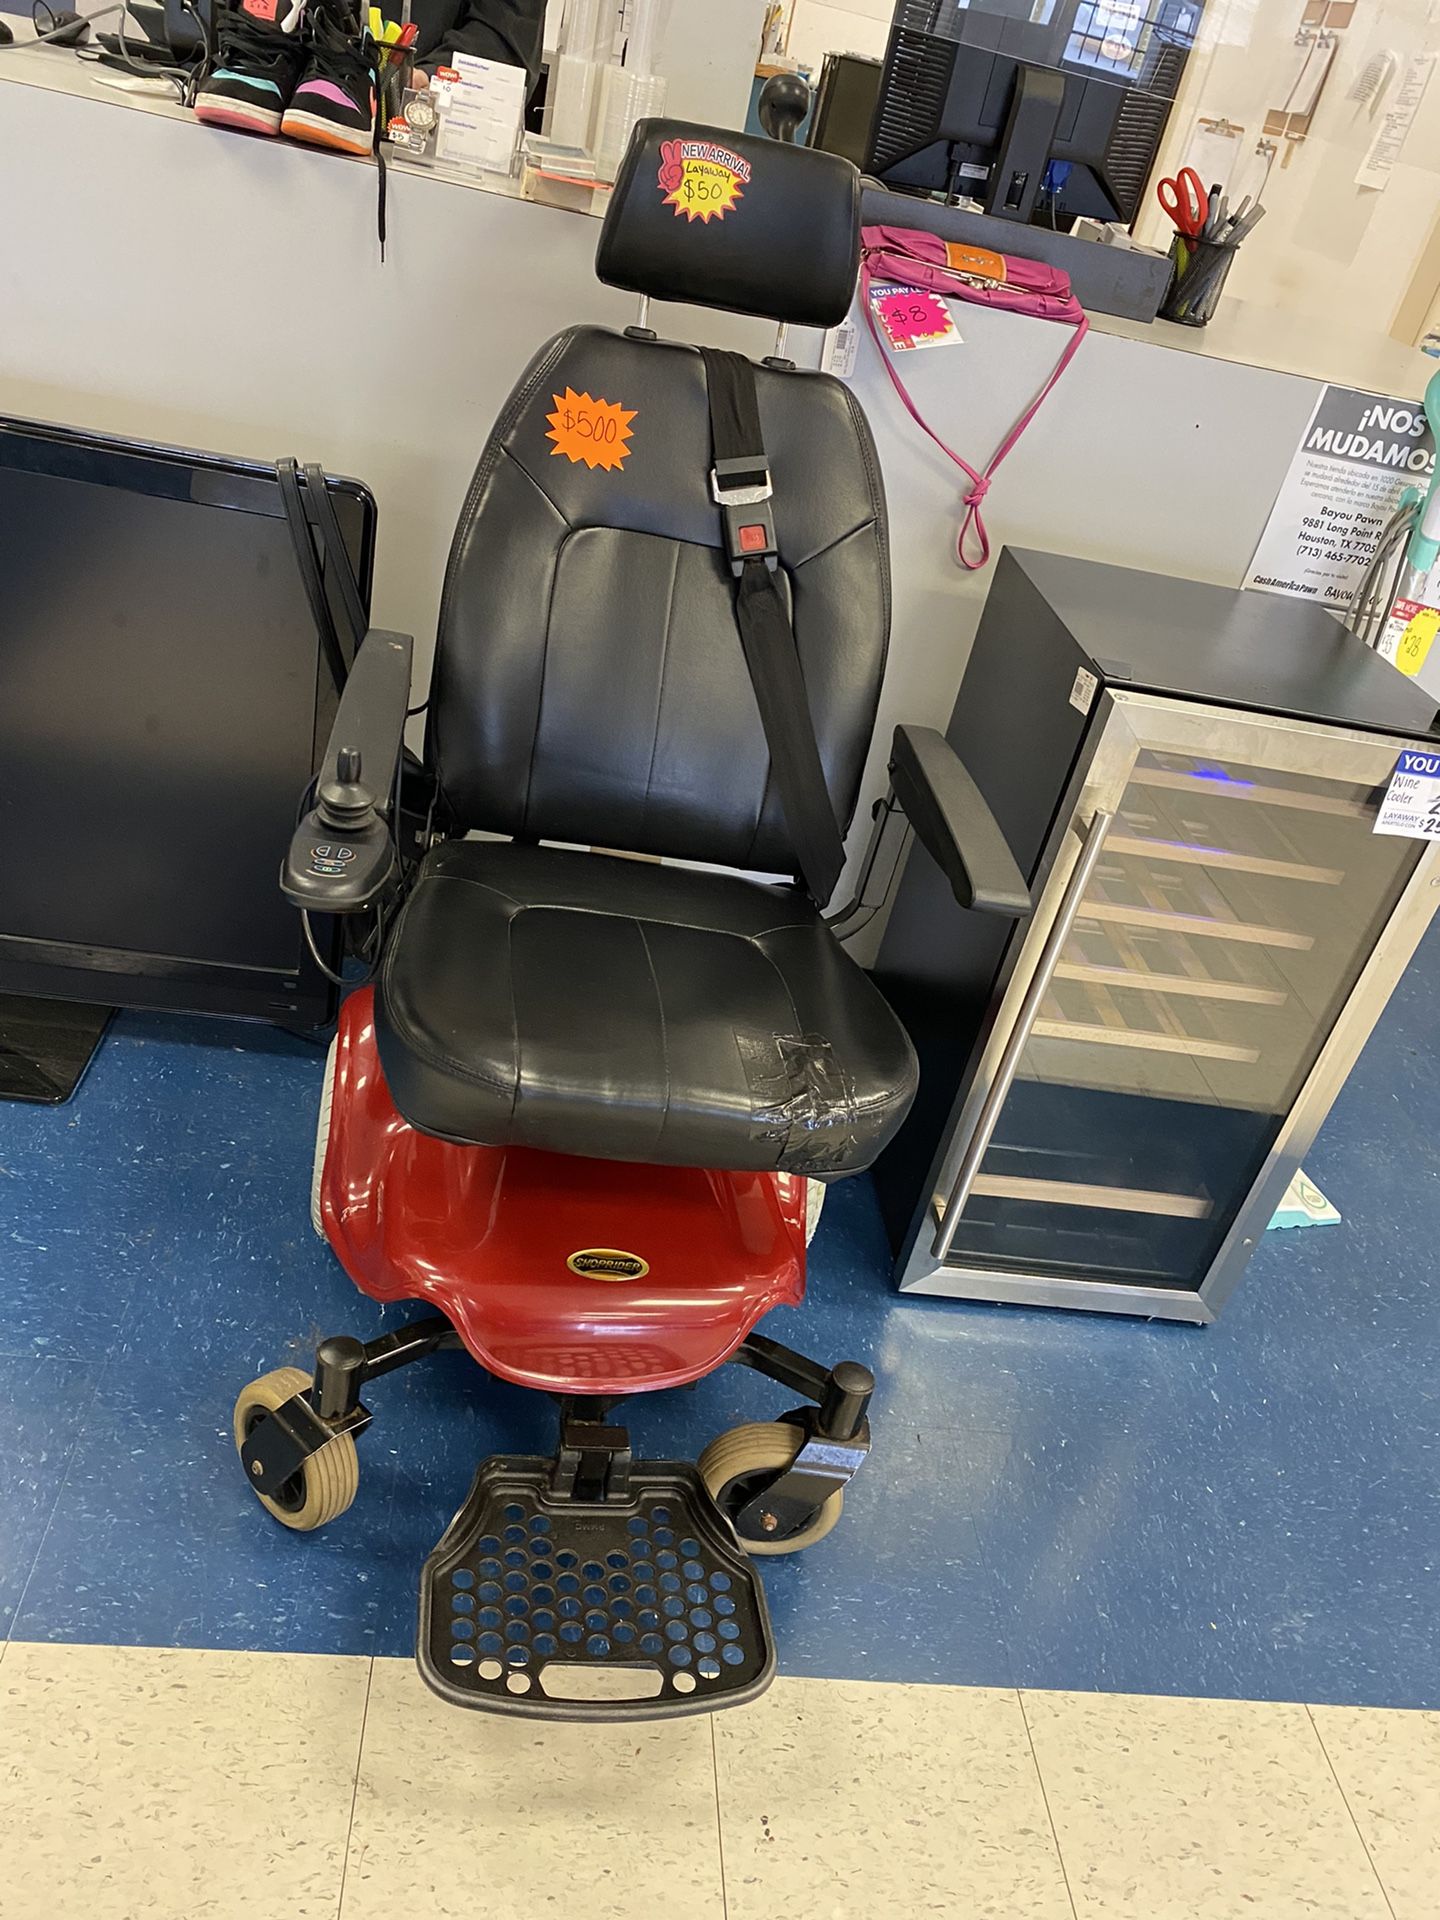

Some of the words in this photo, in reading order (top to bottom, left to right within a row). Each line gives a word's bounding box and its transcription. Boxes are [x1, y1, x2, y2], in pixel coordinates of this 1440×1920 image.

[682, 144, 708, 158] NEW
[708, 148, 751, 180] ARRIVAL
[686, 161, 731, 183] Layaway
[683, 179, 722, 202] $50
[870, 288, 892, 298] YOU
[892, 287, 909, 295] PAY
[891, 305, 928, 326] $8
[561, 408, 617, 444] $500
[1357, 404, 1427, 437] ¡NOS
[1320, 506, 1353, 521] Bayou
[1355, 513, 1383, 526] Pawn
[1302, 516, 1324, 531] 9881
[1326, 521, 1349, 539] Long
[1350, 526, 1375, 540] Point
[1374, 530, 1383, 541] R
[1297, 530, 1337, 548] Houston,
[1339, 538, 1352, 550] TX
[1352, 540, 1377, 554] 7705
[1296, 544, 1323, 560] (713)
[1323, 550, 1371, 567] 465-7702
[1404, 754, 1440, 774] YOU
[1392, 774, 1421, 789] Wine
[1386, 789, 1413, 804] Cooler
[1383, 811, 1421, 822] LAYAWAY
[573, 1257, 641, 1272] SHOPRIDER
